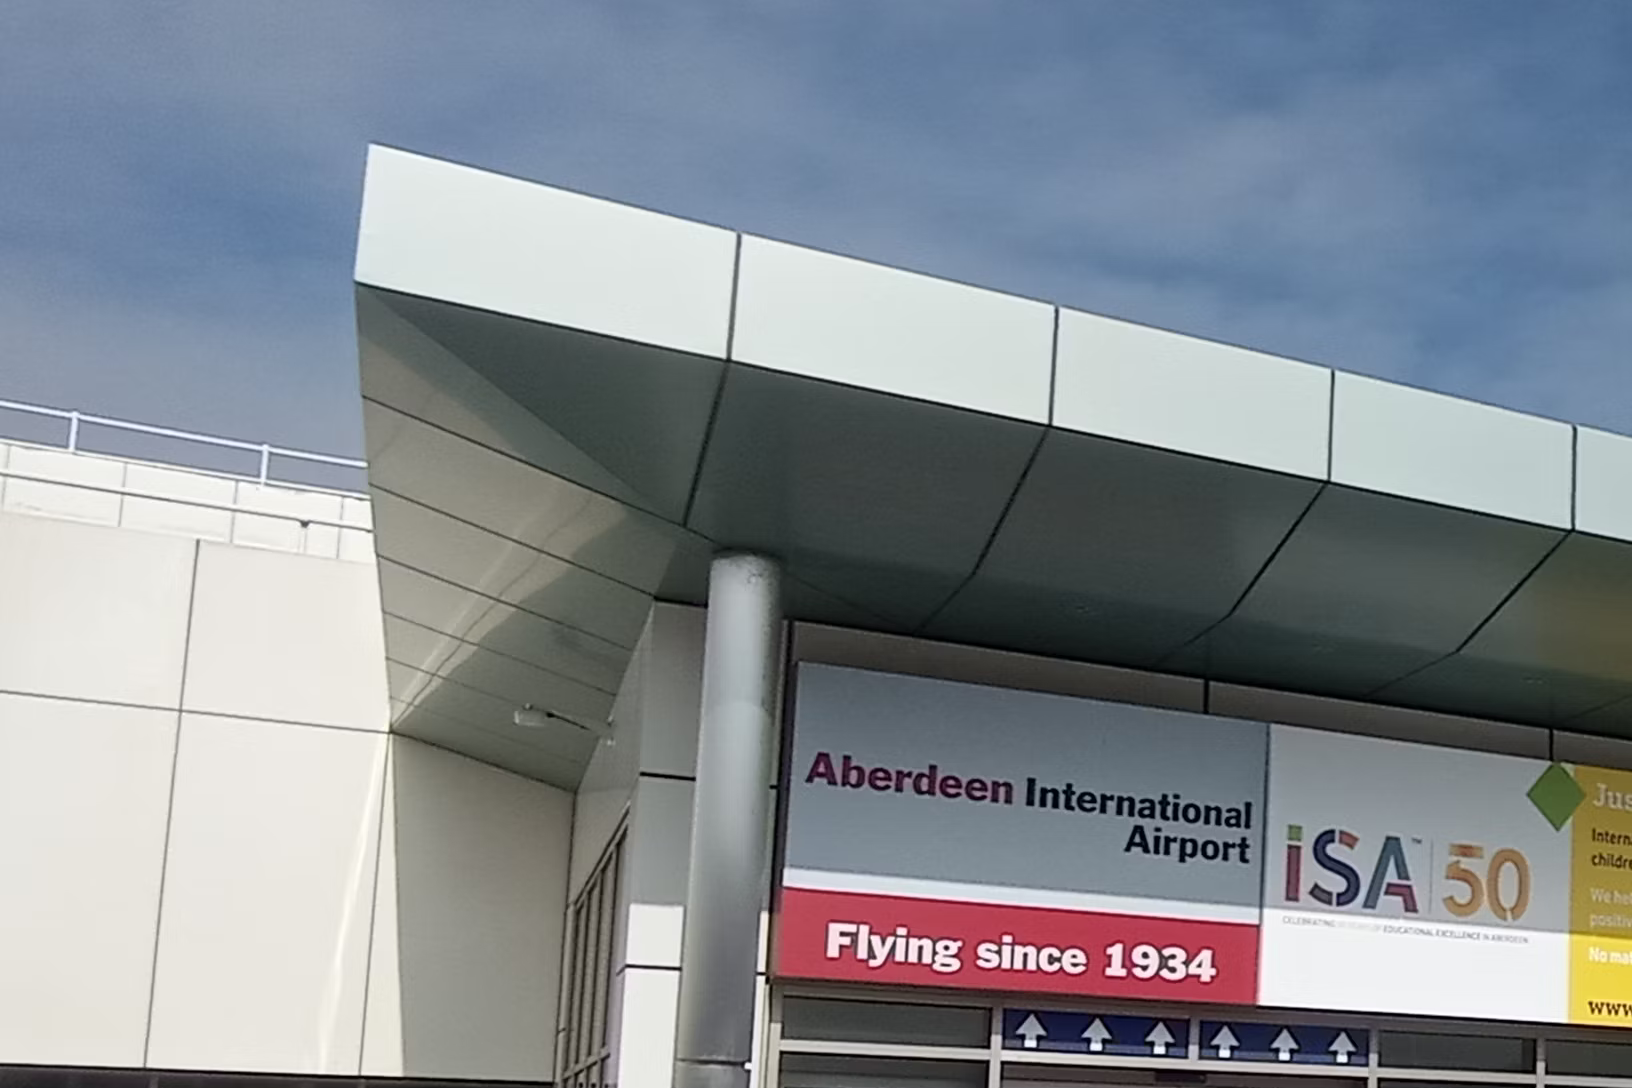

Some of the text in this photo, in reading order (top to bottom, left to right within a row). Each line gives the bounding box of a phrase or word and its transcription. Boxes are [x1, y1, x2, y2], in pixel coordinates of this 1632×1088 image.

[804, 751, 1253, 831] Aberdeen International
[1123, 823, 1251, 865] Airport
[1442, 843, 1531, 923] 50
[1590, 887, 1611, 903] We
[825, 921, 1218, 984] Flying since 1934
[1588, 946, 1607, 963] No
